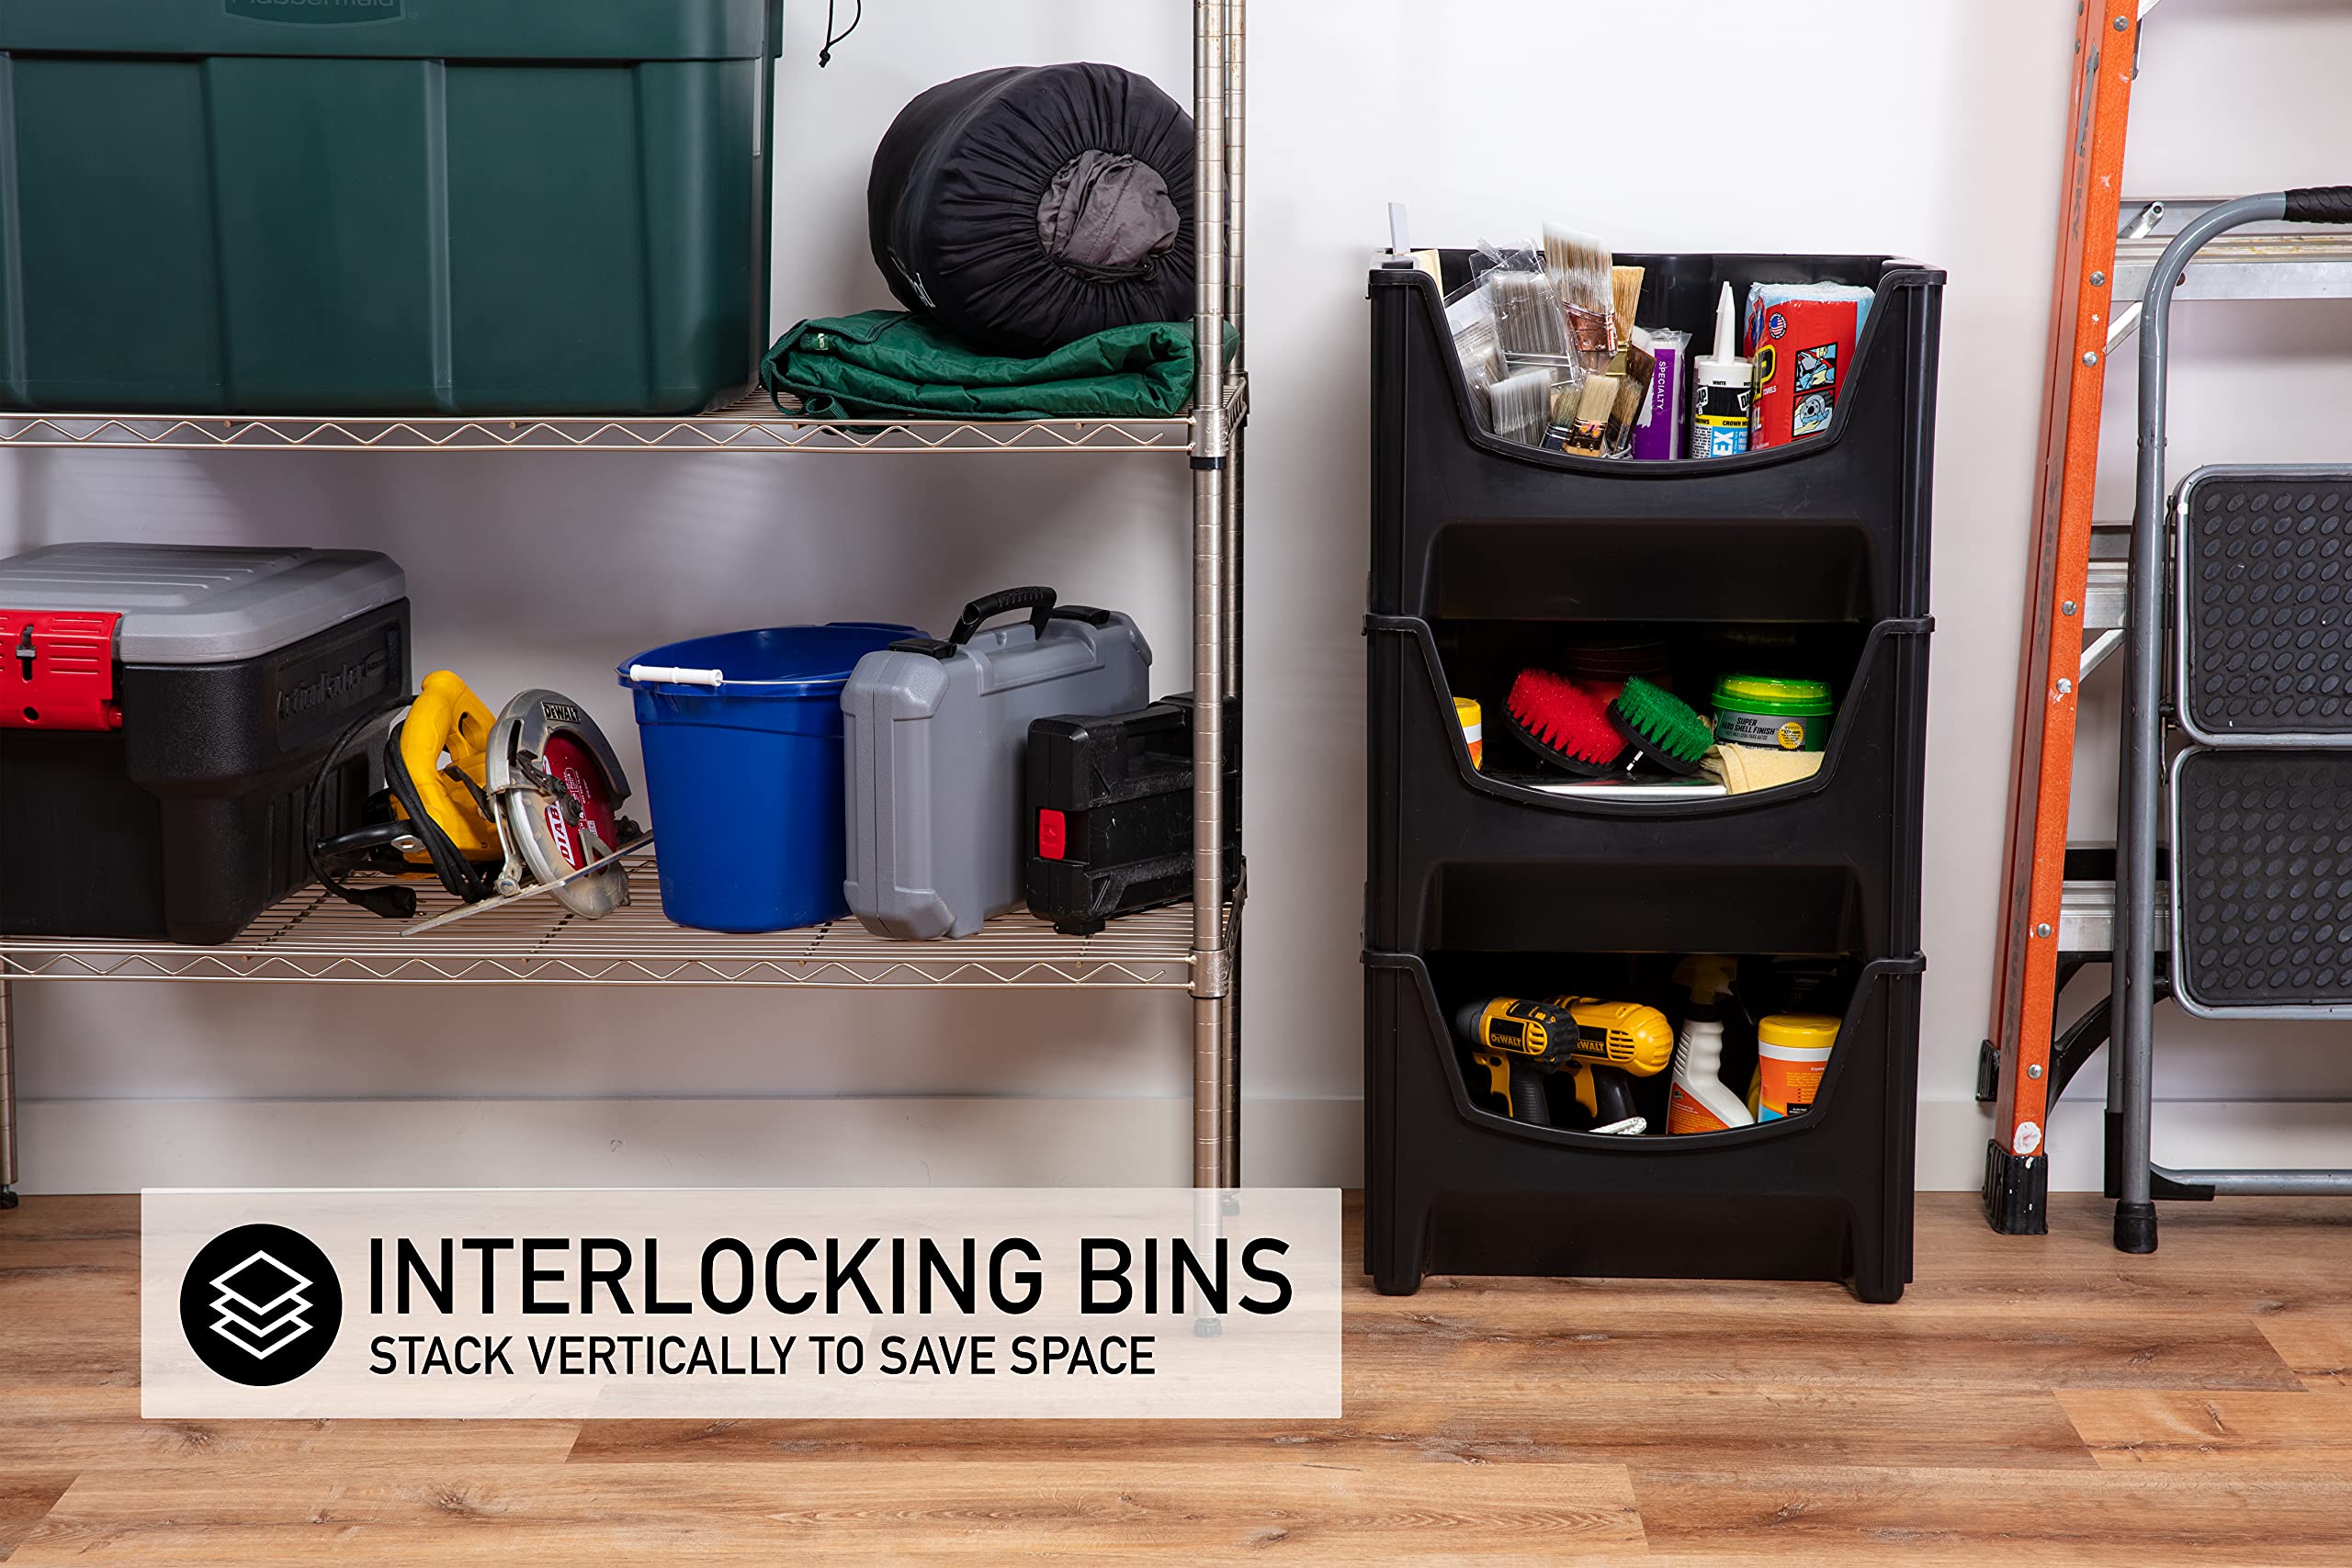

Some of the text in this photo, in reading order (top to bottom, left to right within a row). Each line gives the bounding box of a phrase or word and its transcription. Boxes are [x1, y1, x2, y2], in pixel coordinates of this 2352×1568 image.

[1657, 361, 1667, 410] SPECIALTY
[544, 704, 579, 722] DEWALT
[1736, 717, 1758, 726] SUPER
[1735, 725, 1754, 733] SHELL
[1753, 727, 1776, 735] FINISH
[1491, 1033, 1521, 1046] DEWALT
